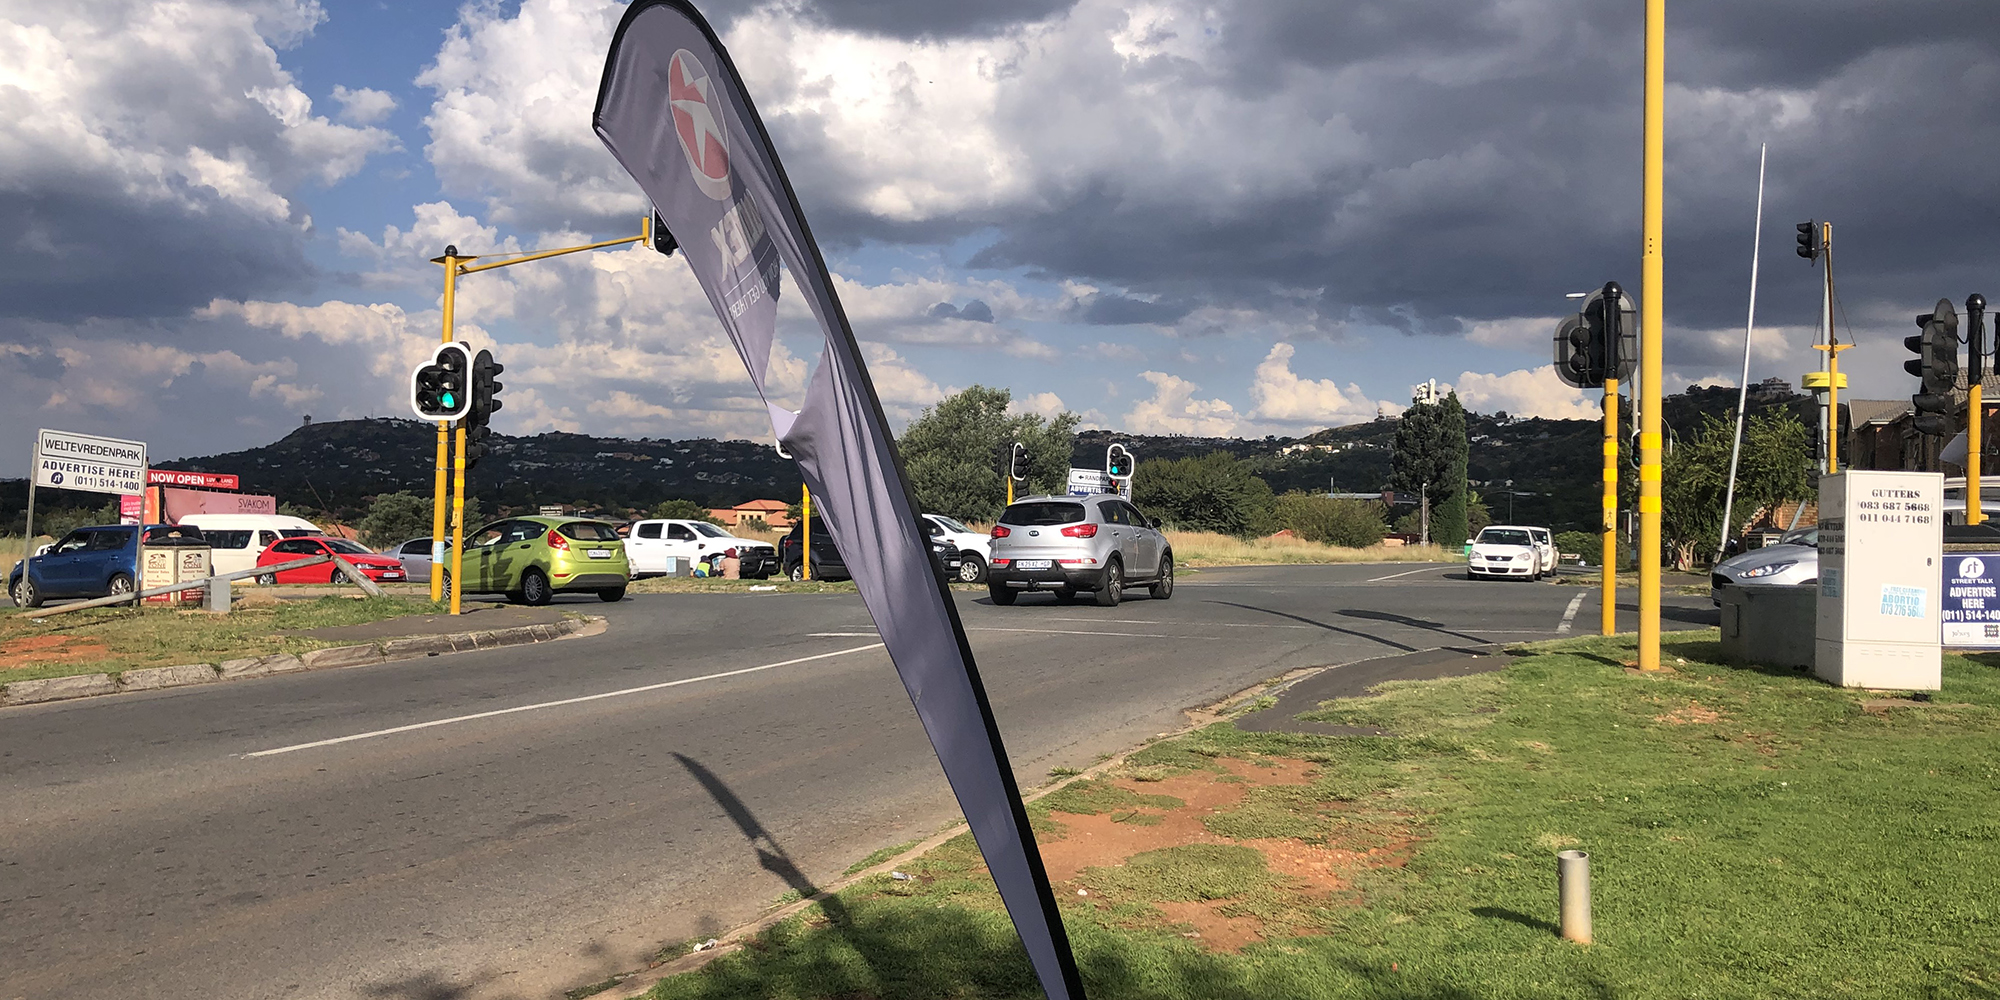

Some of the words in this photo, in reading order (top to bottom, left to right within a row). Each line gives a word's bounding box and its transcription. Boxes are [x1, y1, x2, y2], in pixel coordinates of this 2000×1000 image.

[45, 438, 140, 460] WELTEVREDENPARK
[42, 460, 105, 476] ADVERTISE
[108, 470, 140, 480] HERE!
[74, 476, 98, 488] (011)
[100, 480, 140, 491] 514-1400
[151, 472, 176, 483] NOW
[177, 474, 204, 485] OPEN
[1872, 489, 1920, 498] GUTTERS
[238, 498, 270, 509] SVAKOM
[1860, 501, 1880, 510] 083
[1882, 502, 1901, 510] 687
[1860, 514, 1878, 522] 011
[1905, 515, 1930, 524] 7168
[1950, 586, 1996, 598] ADVERTISE
[1962, 598, 1985, 608] HERE
[1880, 603, 1893, 615] 073
[1894, 604, 1906, 616] 276
[1942, 610, 1964, 622] (011)
